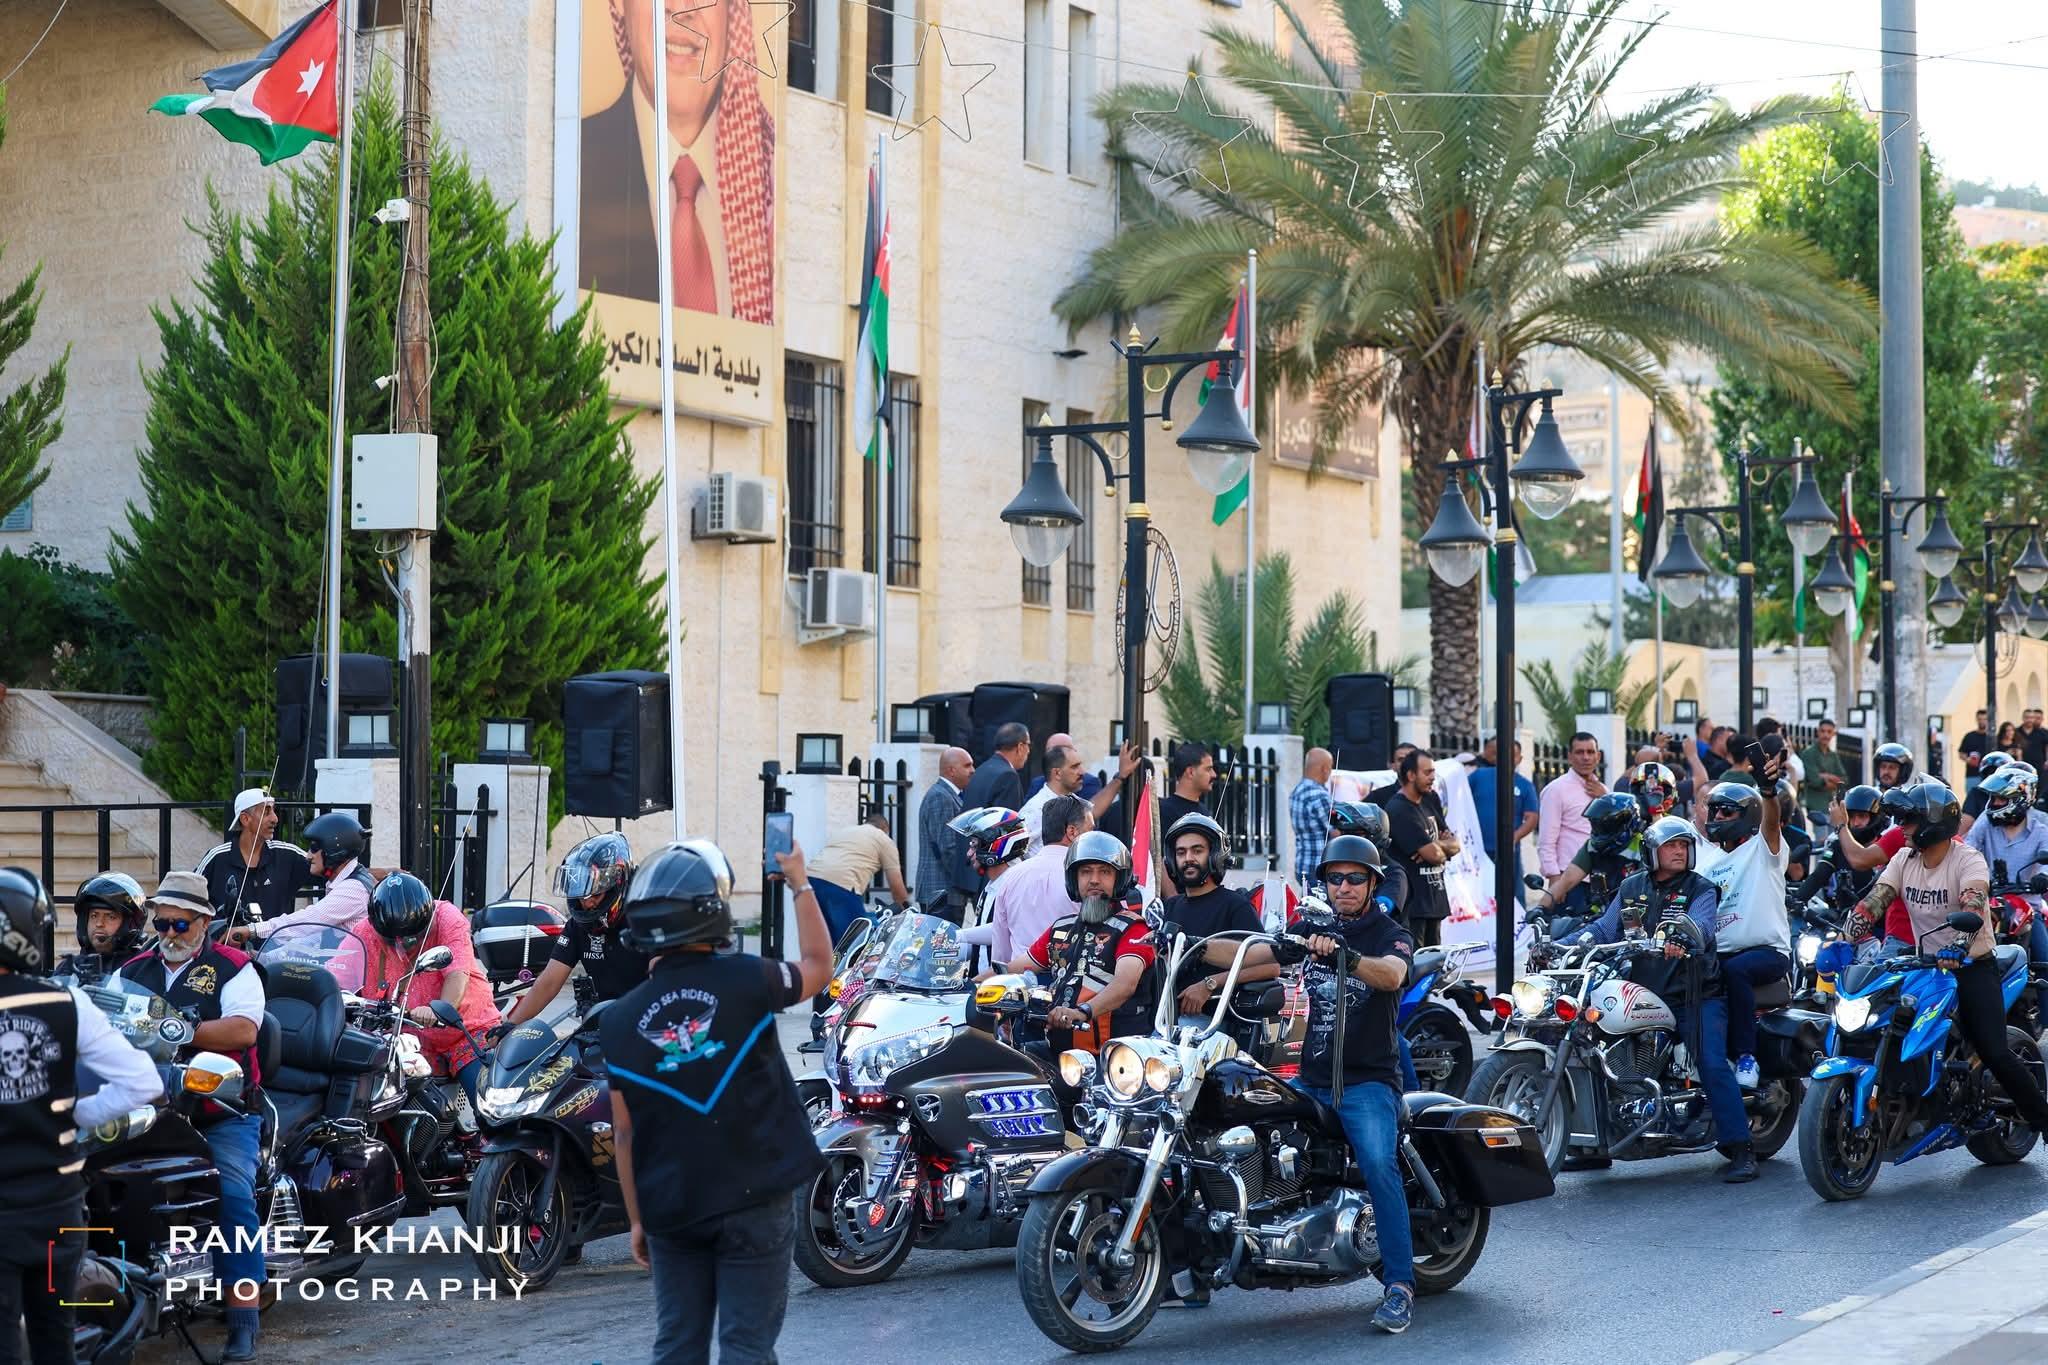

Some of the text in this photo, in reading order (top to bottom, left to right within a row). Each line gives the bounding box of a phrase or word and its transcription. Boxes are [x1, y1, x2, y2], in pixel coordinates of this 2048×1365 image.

[606, 331, 651, 372] الكبر
[713, 345, 761, 399] بلدية
[0, 1019, 10, 1033] ST
[638, 988, 717, 1031] DEAD SEA RIDERS
[0, 1089, 18, 1101] IDE
